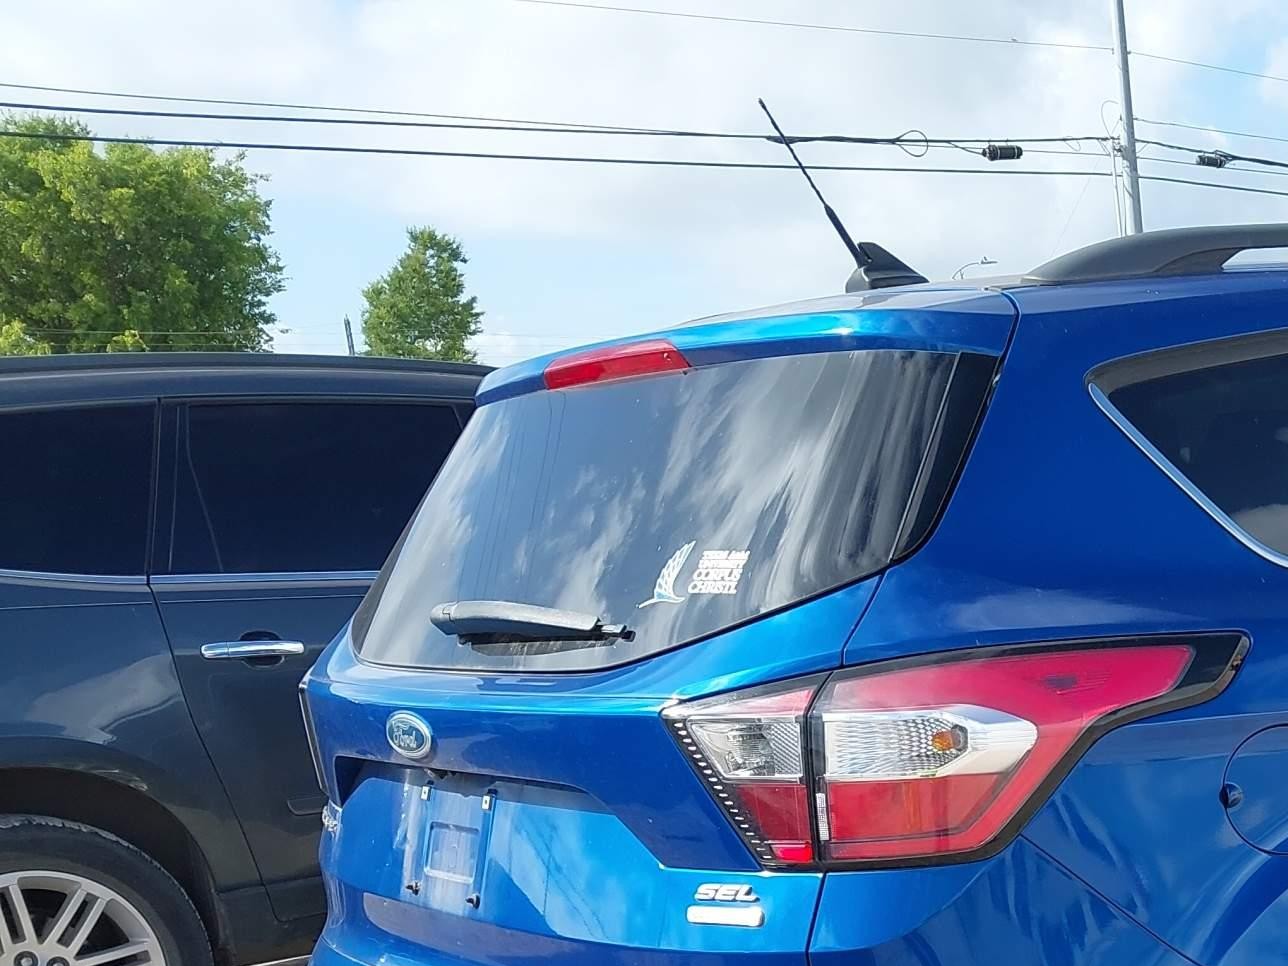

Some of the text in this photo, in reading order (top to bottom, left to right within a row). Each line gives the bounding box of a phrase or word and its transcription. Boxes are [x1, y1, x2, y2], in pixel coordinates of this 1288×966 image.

[692, 569, 743, 581] CORPUS
[687, 581, 738, 595] CHRISTI
[694, 883, 760, 903] SEL
